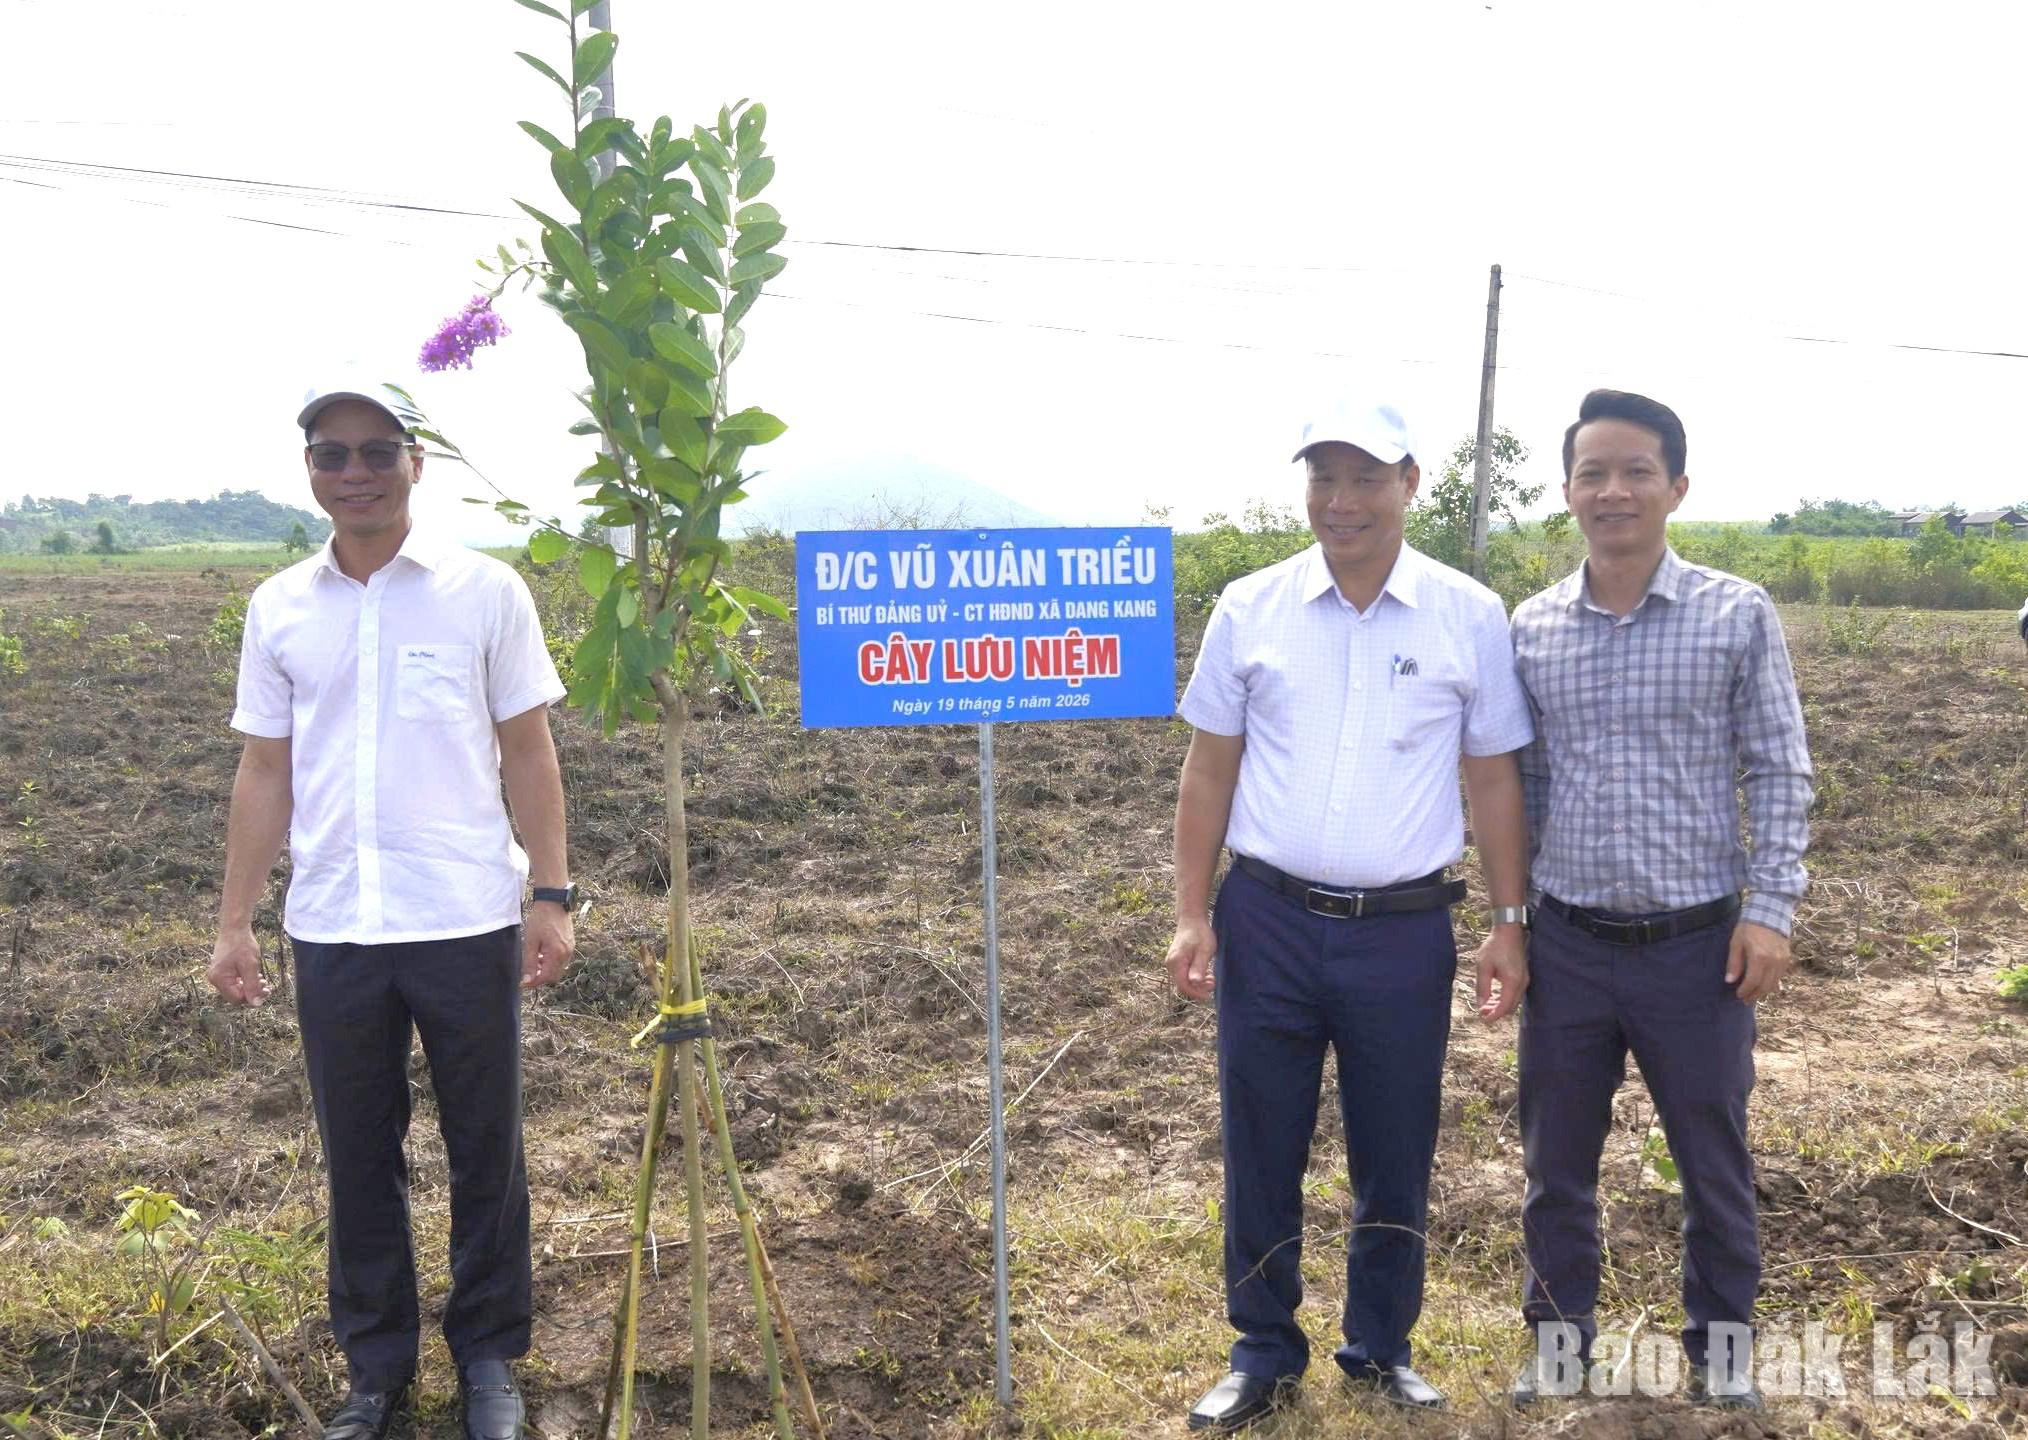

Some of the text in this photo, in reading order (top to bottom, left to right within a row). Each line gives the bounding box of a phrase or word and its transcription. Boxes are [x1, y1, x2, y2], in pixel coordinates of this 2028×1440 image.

[815, 535, 1156, 591] Đ/C VŨ XUÂN TRIỀU
[816, 602, 834, 625] BÍ
[838, 604, 872, 624] THƯ
[875, 600, 922, 624] ĐẢNG
[927, 598, 948, 622] UỶ
[964, 603, 984, 621] CT
[989, 602, 1034, 621] HĐND
[1039, 598, 1060, 620] XÃ
[1114, 600, 1157, 618] KANG
[859, 628, 1120, 686] CÂY LƯU NIỆM
[892, 694, 1091, 715] Ngày 19 tháng 5 năm 2026
